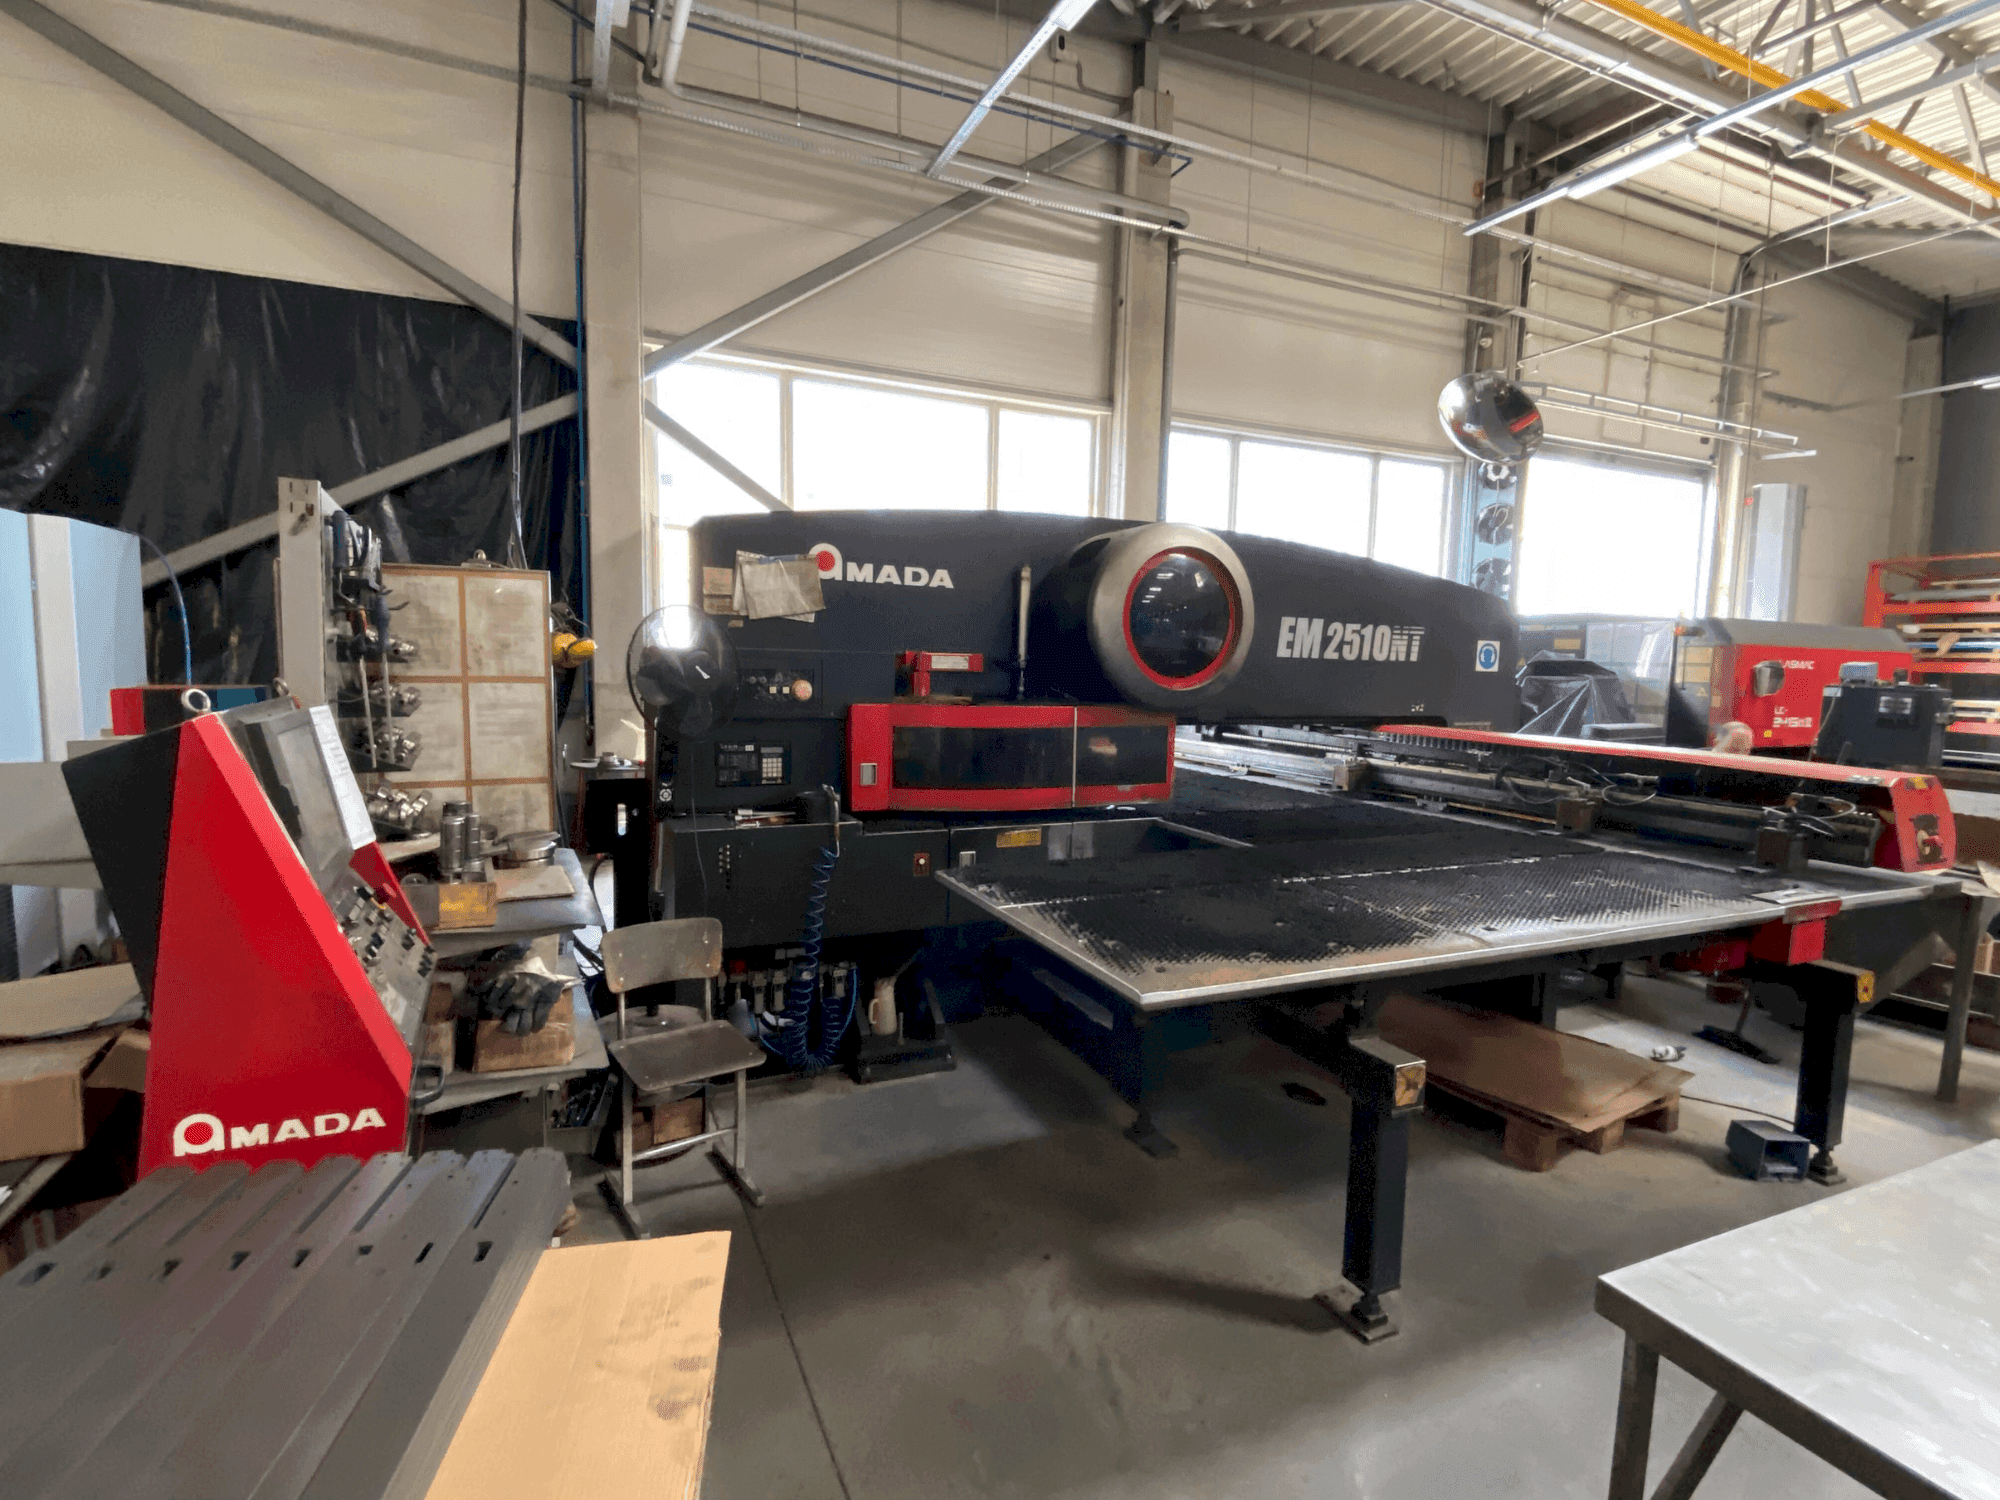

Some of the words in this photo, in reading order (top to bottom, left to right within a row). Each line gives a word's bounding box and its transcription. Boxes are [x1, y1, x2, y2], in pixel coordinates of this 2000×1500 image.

[808, 542, 955, 589] AMADA
[1276, 616, 1325, 659] EM
[173, 1107, 387, 1157] AMADA
